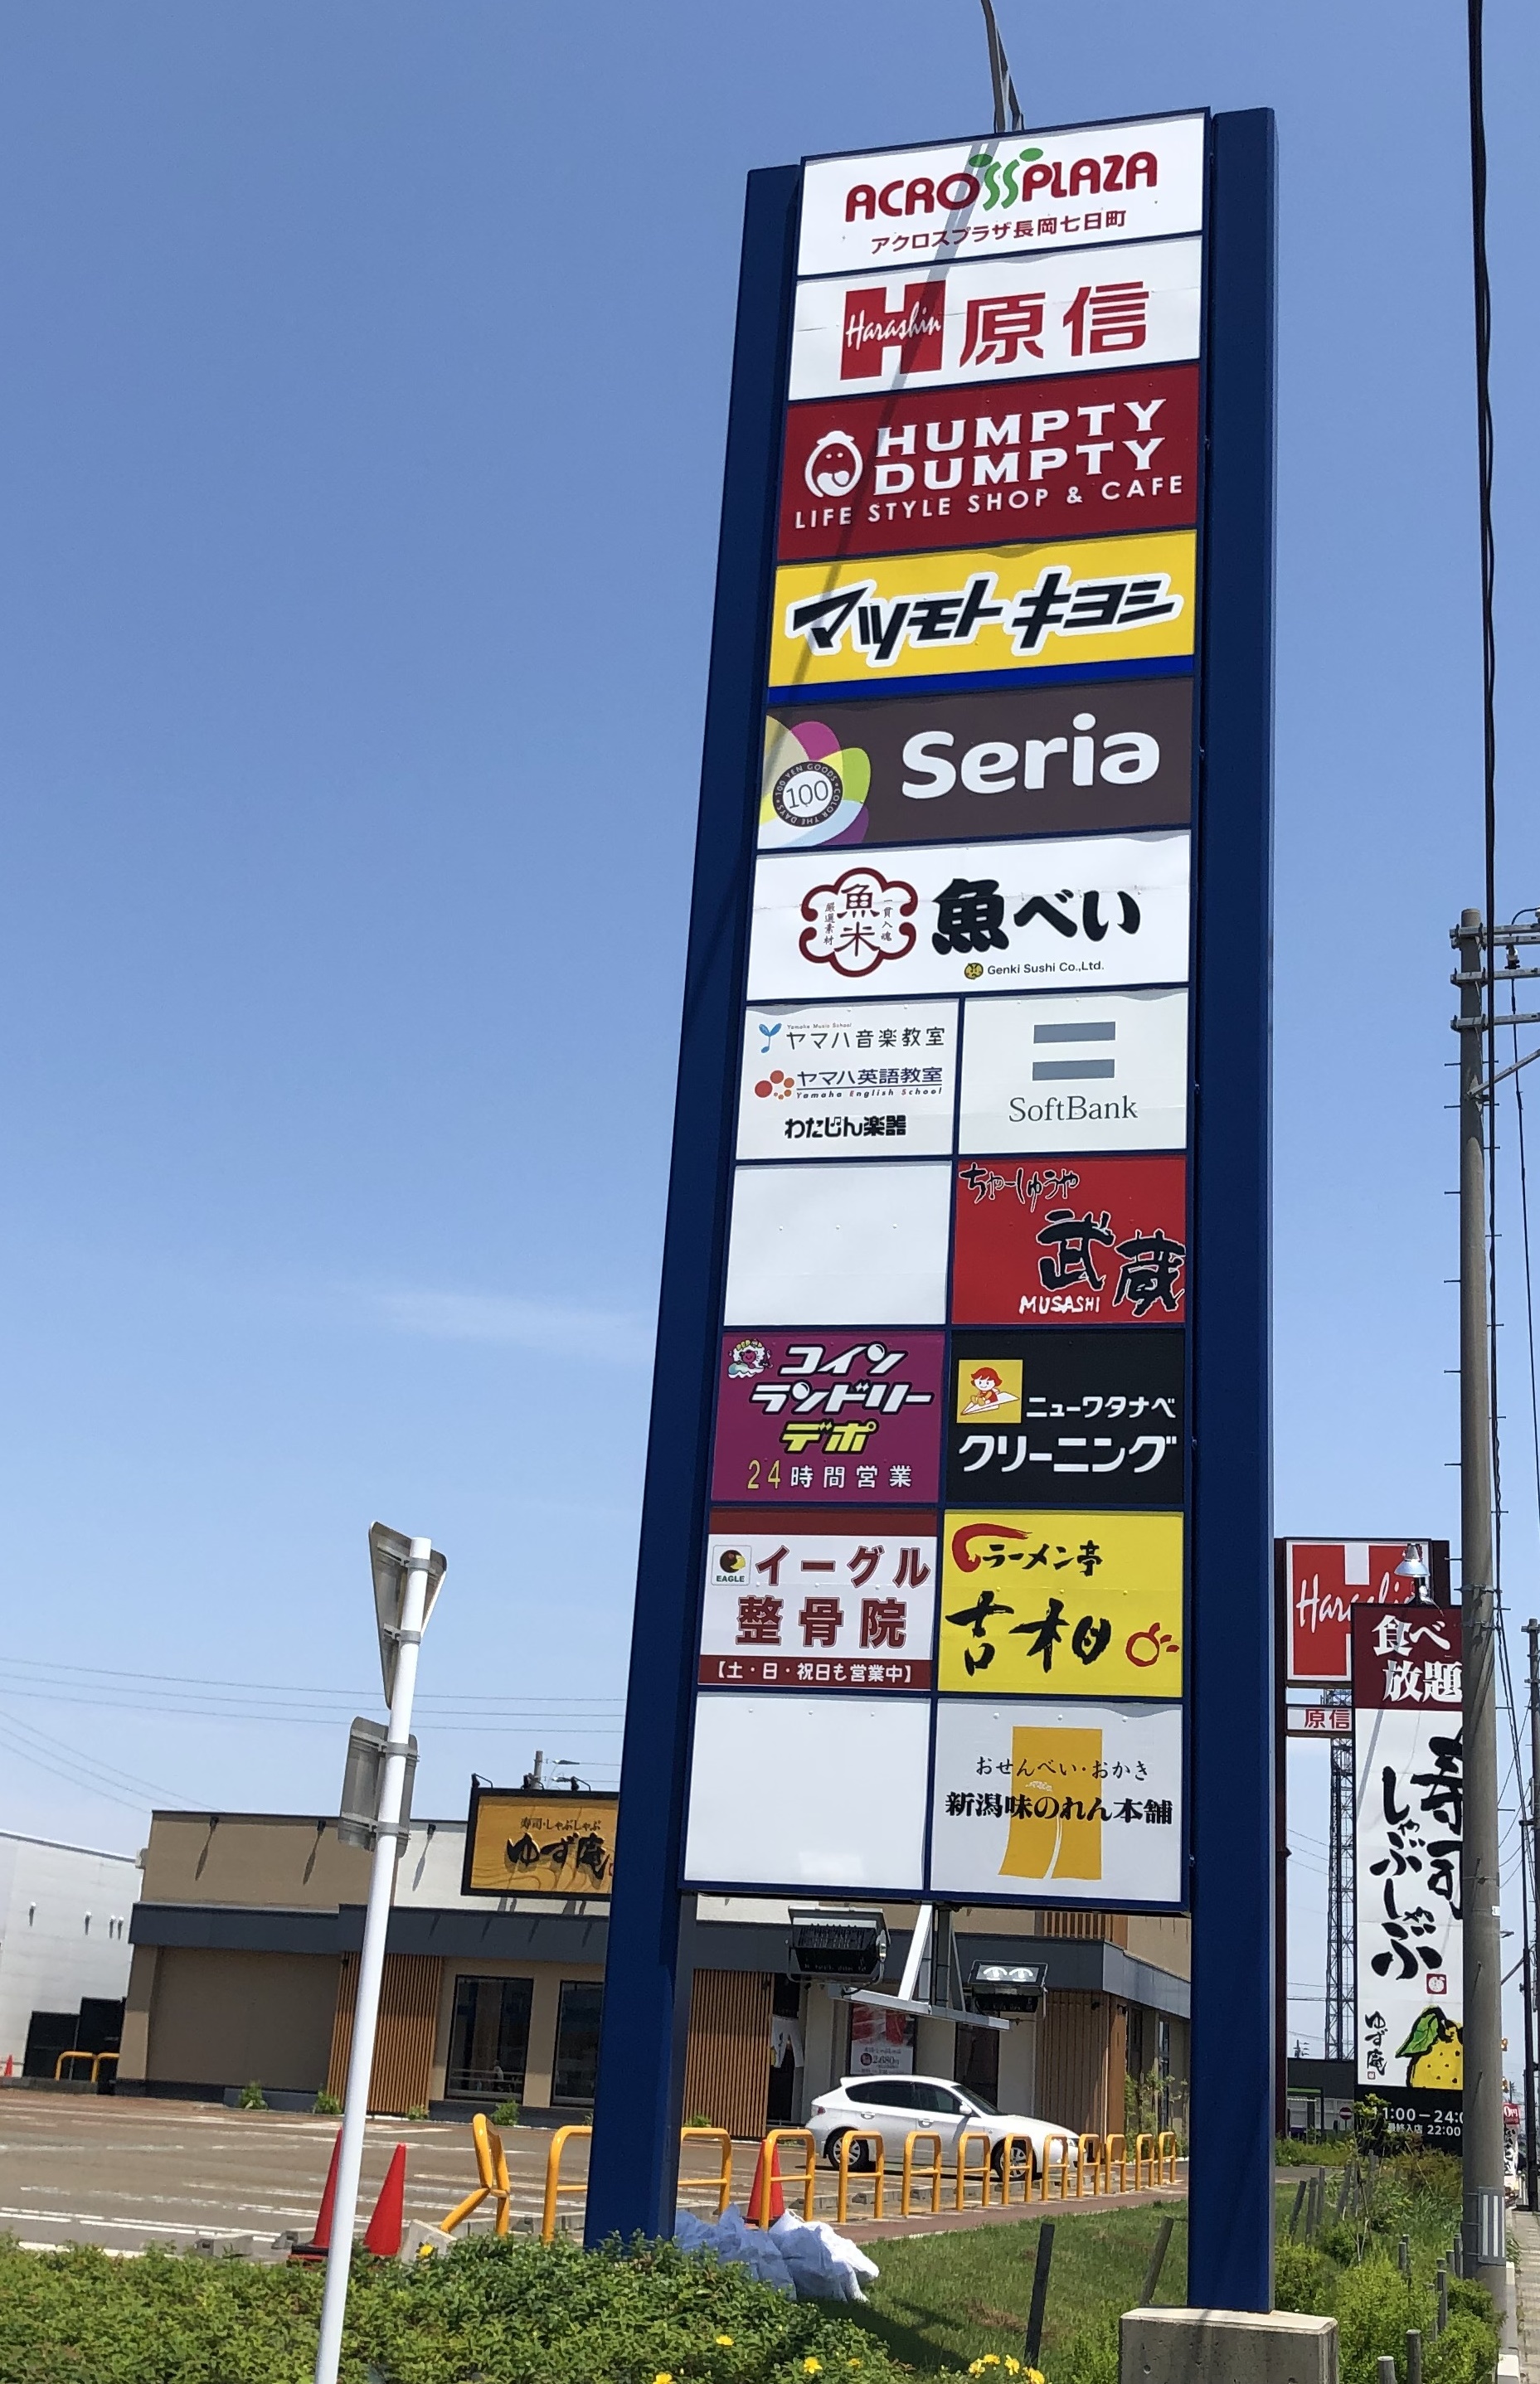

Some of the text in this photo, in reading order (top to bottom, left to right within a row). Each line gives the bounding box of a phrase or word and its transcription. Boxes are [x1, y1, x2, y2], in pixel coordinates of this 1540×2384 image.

[871, 209, 1127, 255] アクロスプラザ長岡七日町
[845, 301, 941, 351] Harashin
[959, 280, 1150, 368] 原信
[876, 398, 1167, 458] HUMPTY
[873, 436, 1166, 496] DUMPTY
[794, 474, 1183, 529] LIFE STYLE SHOP & CAFE
[789, 570, 1178, 661] マツモトキヨシ
[785, 765, 804, 779] YEN
[807, 763, 838, 782] GOODS
[901, 712, 1160, 800] Seria
[785, 779, 828, 809] 100
[822, 788, 841, 818] COLOR
[776, 804, 798, 823] DAYS
[931, 877, 1141, 955] 魚べい
[987, 964, 1021, 975] Genki
[1023, 962, 1056, 974] Sushi
[786, 1026, 945, 1051] ヤマハ音楽教室
[796, 1087, 943, 1100] Yamaha English School
[797, 1066, 944, 1087] ヤマハ英語教室
[1008, 1095, 1139, 1123] SoftBank
[1036, 1208, 1187, 1318] 武蔵
[1018, 1294, 1100, 1315] MUSASHI
[779, 1342, 908, 1377] コイン
[750, 1381, 934, 1414] ランドリー
[1025, 1395, 1177, 1420] ニューワタナベ
[781, 1420, 877, 1454] デポ
[959, 1435, 1178, 1473] クリーニング
[747, 1459, 912, 1490] 24時間営業
[754, 1545, 931, 1589] イーグル
[982, 1538, 1103, 1576] ラーメン亭
[715, 1575, 746, 1583] EAGLE
[735, 1595, 907, 1650] 整骨院
[1371, 1614, 1451, 1657] 食べ
[1382, 1659, 1463, 1702] 放題
[1304, 1708, 1350, 1729] 原信
[976, 1755, 1149, 1781] おせんべい・おかき
[945, 1790, 1174, 1825] 新潟味のれん本舗
[1426, 2124, 1461, 2137] 22:00
